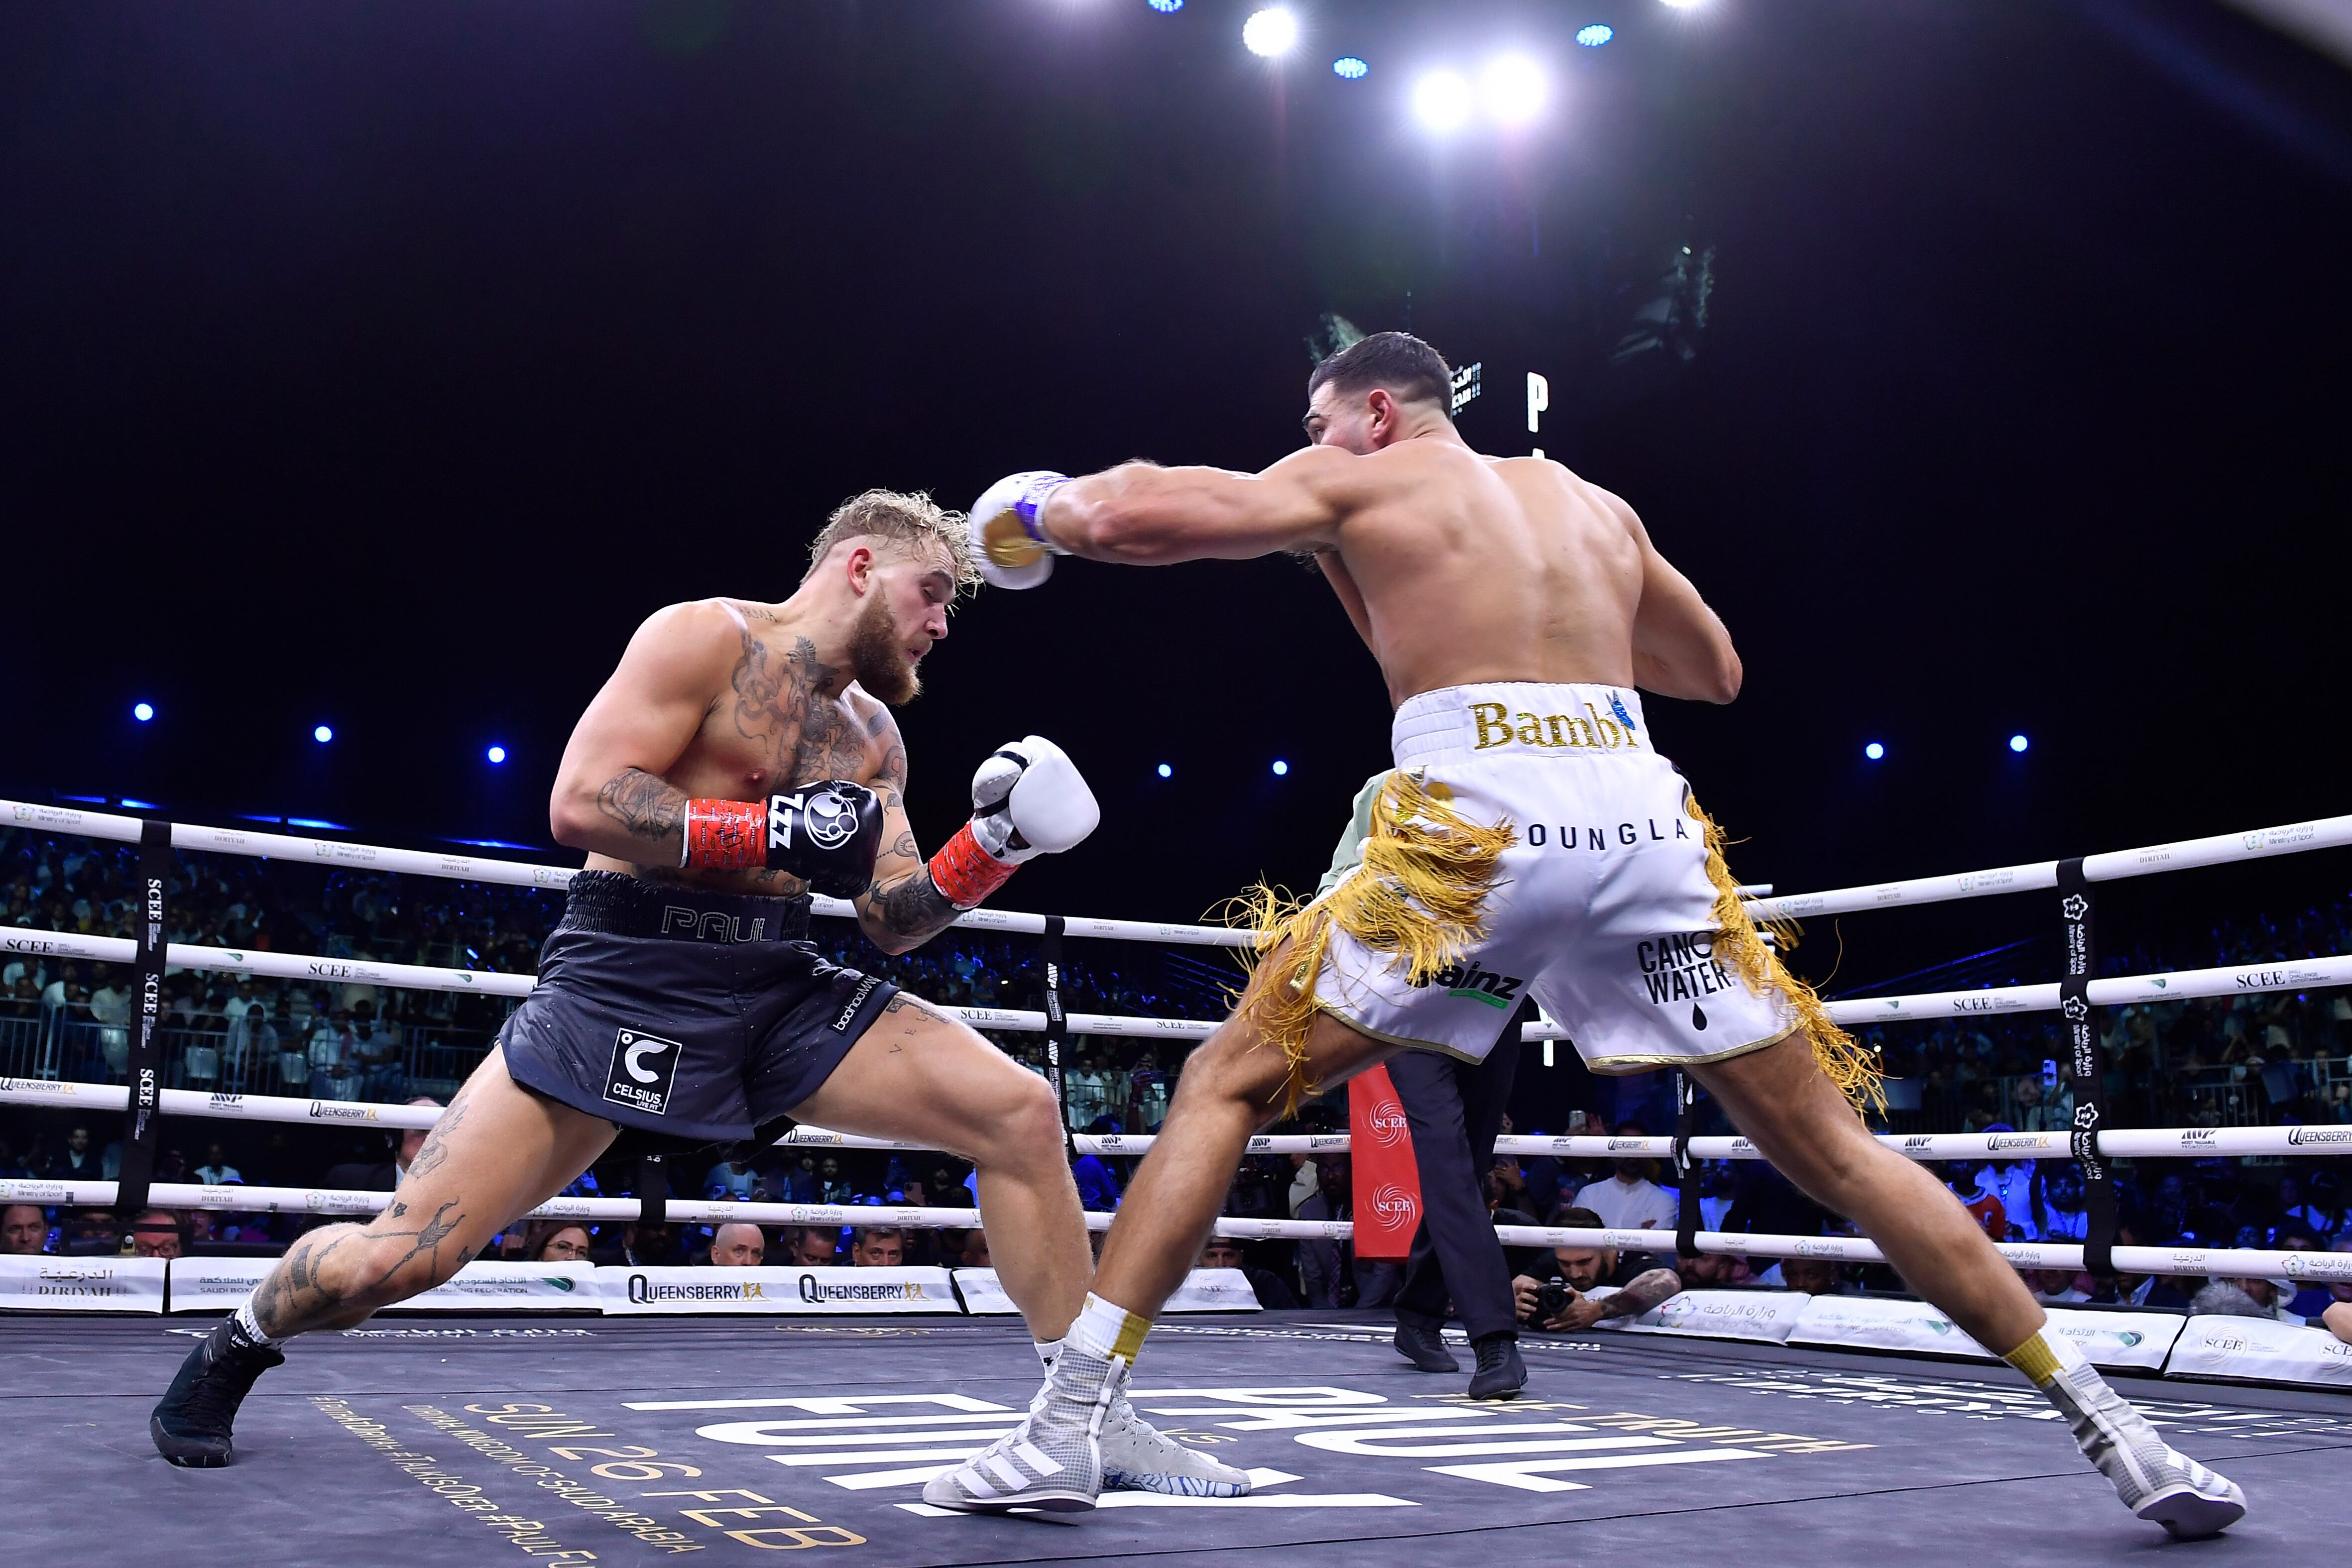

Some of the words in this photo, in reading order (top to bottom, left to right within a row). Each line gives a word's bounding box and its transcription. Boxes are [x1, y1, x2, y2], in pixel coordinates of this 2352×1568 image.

[1468, 702, 1640, 750] Bambi
[1529, 818, 1690, 850] OUNGLA
[148, 878, 162, 920] SCEE
[661, 905, 773, 943] PAUL
[5, 938, 54, 953] SCEE
[308, 963, 352, 978] SCEE
[1644, 959, 1733, 1005] WATER
[2235, 970, 2285, 989] SCEE
[143, 973, 159, 1013] SCEE
[1953, 997, 1992, 1011] SCEE
[961, 1009, 992, 1020] SCEE
[0, 1077, 62, 1092] QUEENSBERRY
[138, 1068, 154, 1106] SCEE
[613, 1083, 662, 1105] CELSIUS
[310, 1101, 366, 1120] QUEENSBERRY
[636, 1100, 649, 1109] LIVE
[1375, 1117, 1407, 1128] SCEE
[788, 1128, 833, 1143] QUEENSBERRY
[1988, 1135, 2038, 1150] QUEENSBERRY
[2288, 1127, 2352, 1145] QUEENSBERRY
[1378, 1201, 1411, 1212] SCEE
[2309, 1260, 2335, 1269] الرياضة
[39, 1267, 114, 1283] الدرعية
[39, 1285, 111, 1297] DIRIYAH
[628, 1274, 740, 1304] QUEENSBERRY
[799, 1274, 903, 1304] QUEENSBERRY
[1703, 1304, 1745, 1317] الرياضة
[1745, 1308, 1776, 1320] وزارة
[2204, 1339, 2243, 1350] SCEE
[2323, 1344, 2352, 1356] SCE
[1558, 1411, 1878, 1455] TRUTH
[447, 1429, 537, 1464] KINGDOM
[464, 1403, 616, 1438] SUN
[547, 1445, 703, 1480] 26
[640, 1488, 867, 1550] FEB
[511, 1465, 566, 1479] OF
[537, 1479, 624, 1509] SAUDI
[592, 1511, 706, 1554] ARABIA
